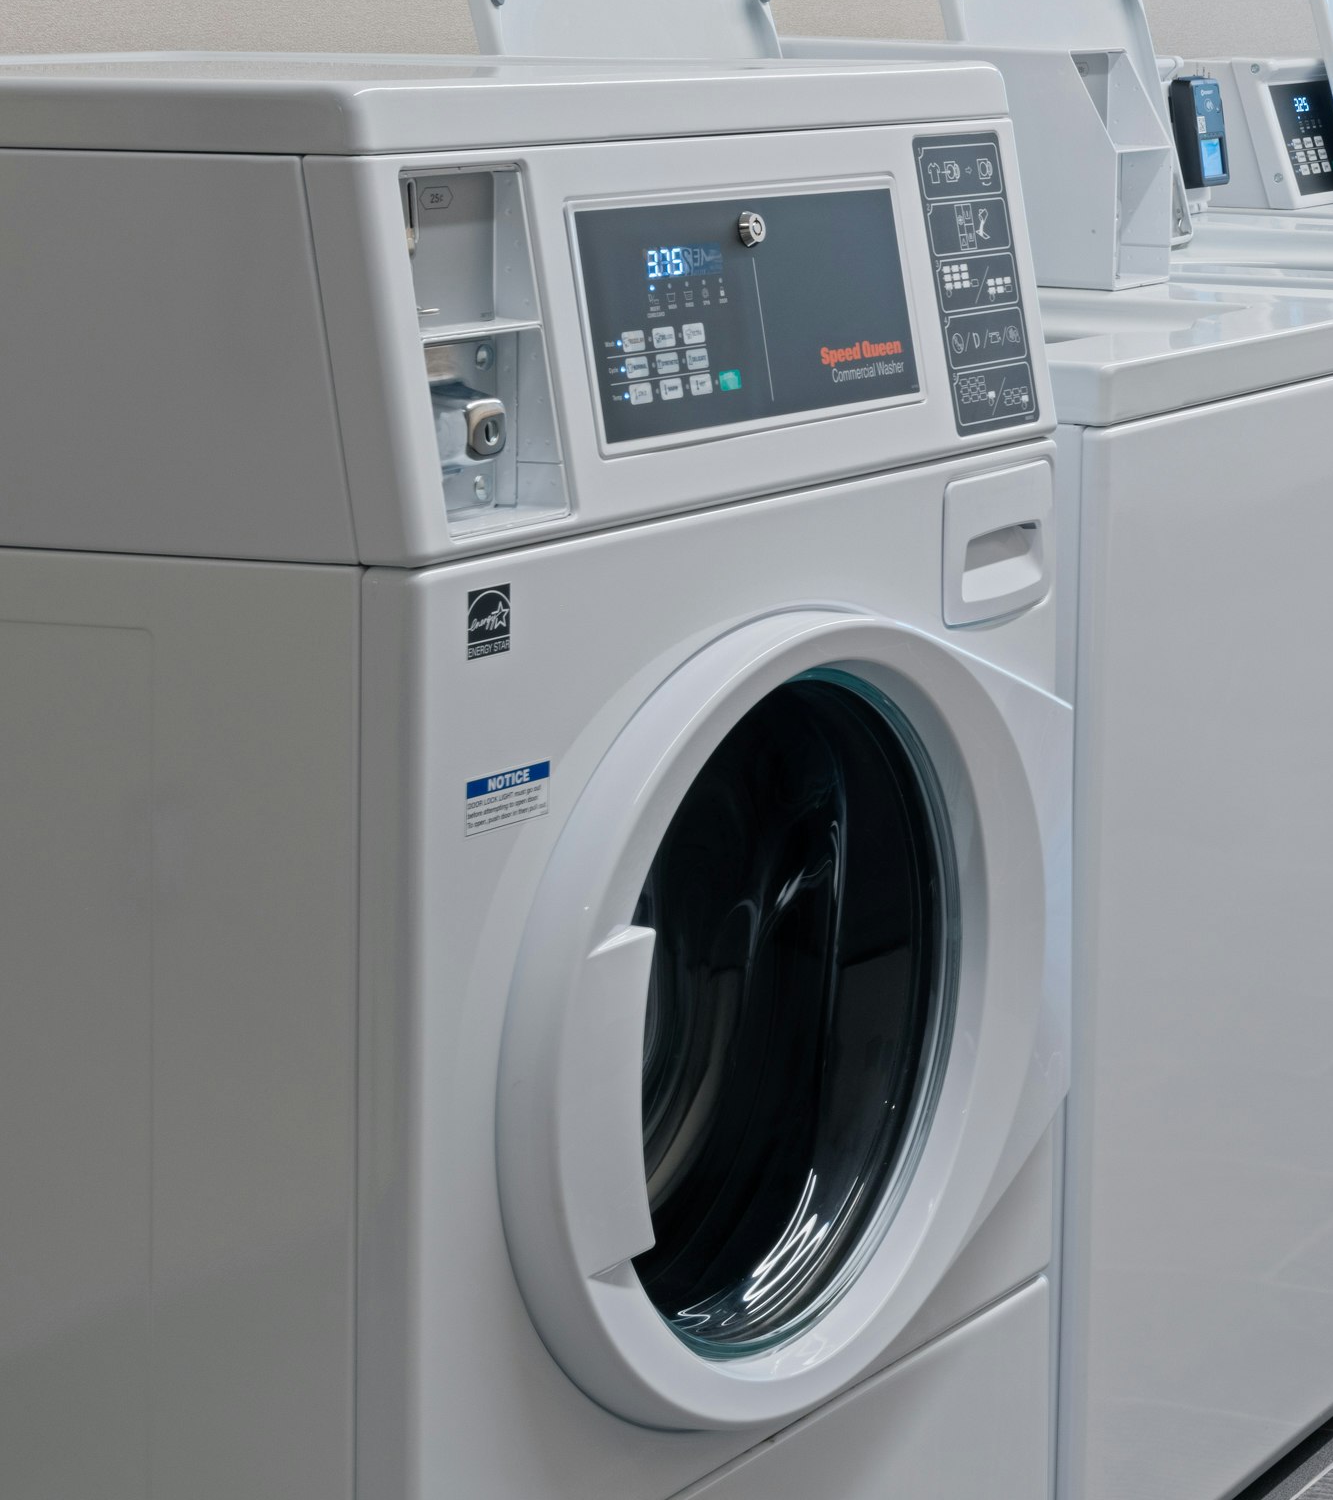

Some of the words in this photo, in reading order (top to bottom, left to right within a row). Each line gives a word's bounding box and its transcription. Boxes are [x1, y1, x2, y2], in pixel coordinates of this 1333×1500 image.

[429, 193, 444, 204] 25¢
[647, 247, 684, 278] 3.75
[820, 342, 861, 368] Speed
[861, 339, 902, 358] Queen
[831, 363, 876, 383] Commercial
[876, 360, 904, 376] Washer
[468, 643, 493, 658] ENERGY
[493, 639, 510, 652] STAR
[487, 768, 530, 792] NOTICE
[467, 800, 483, 810] DOOR
[484, 796, 498, 806] LOCK
[498, 791, 514, 802] LIGHT
[514, 788, 527, 796] must
[515, 799, 527, 807] open
[527, 795, 538, 803] door
